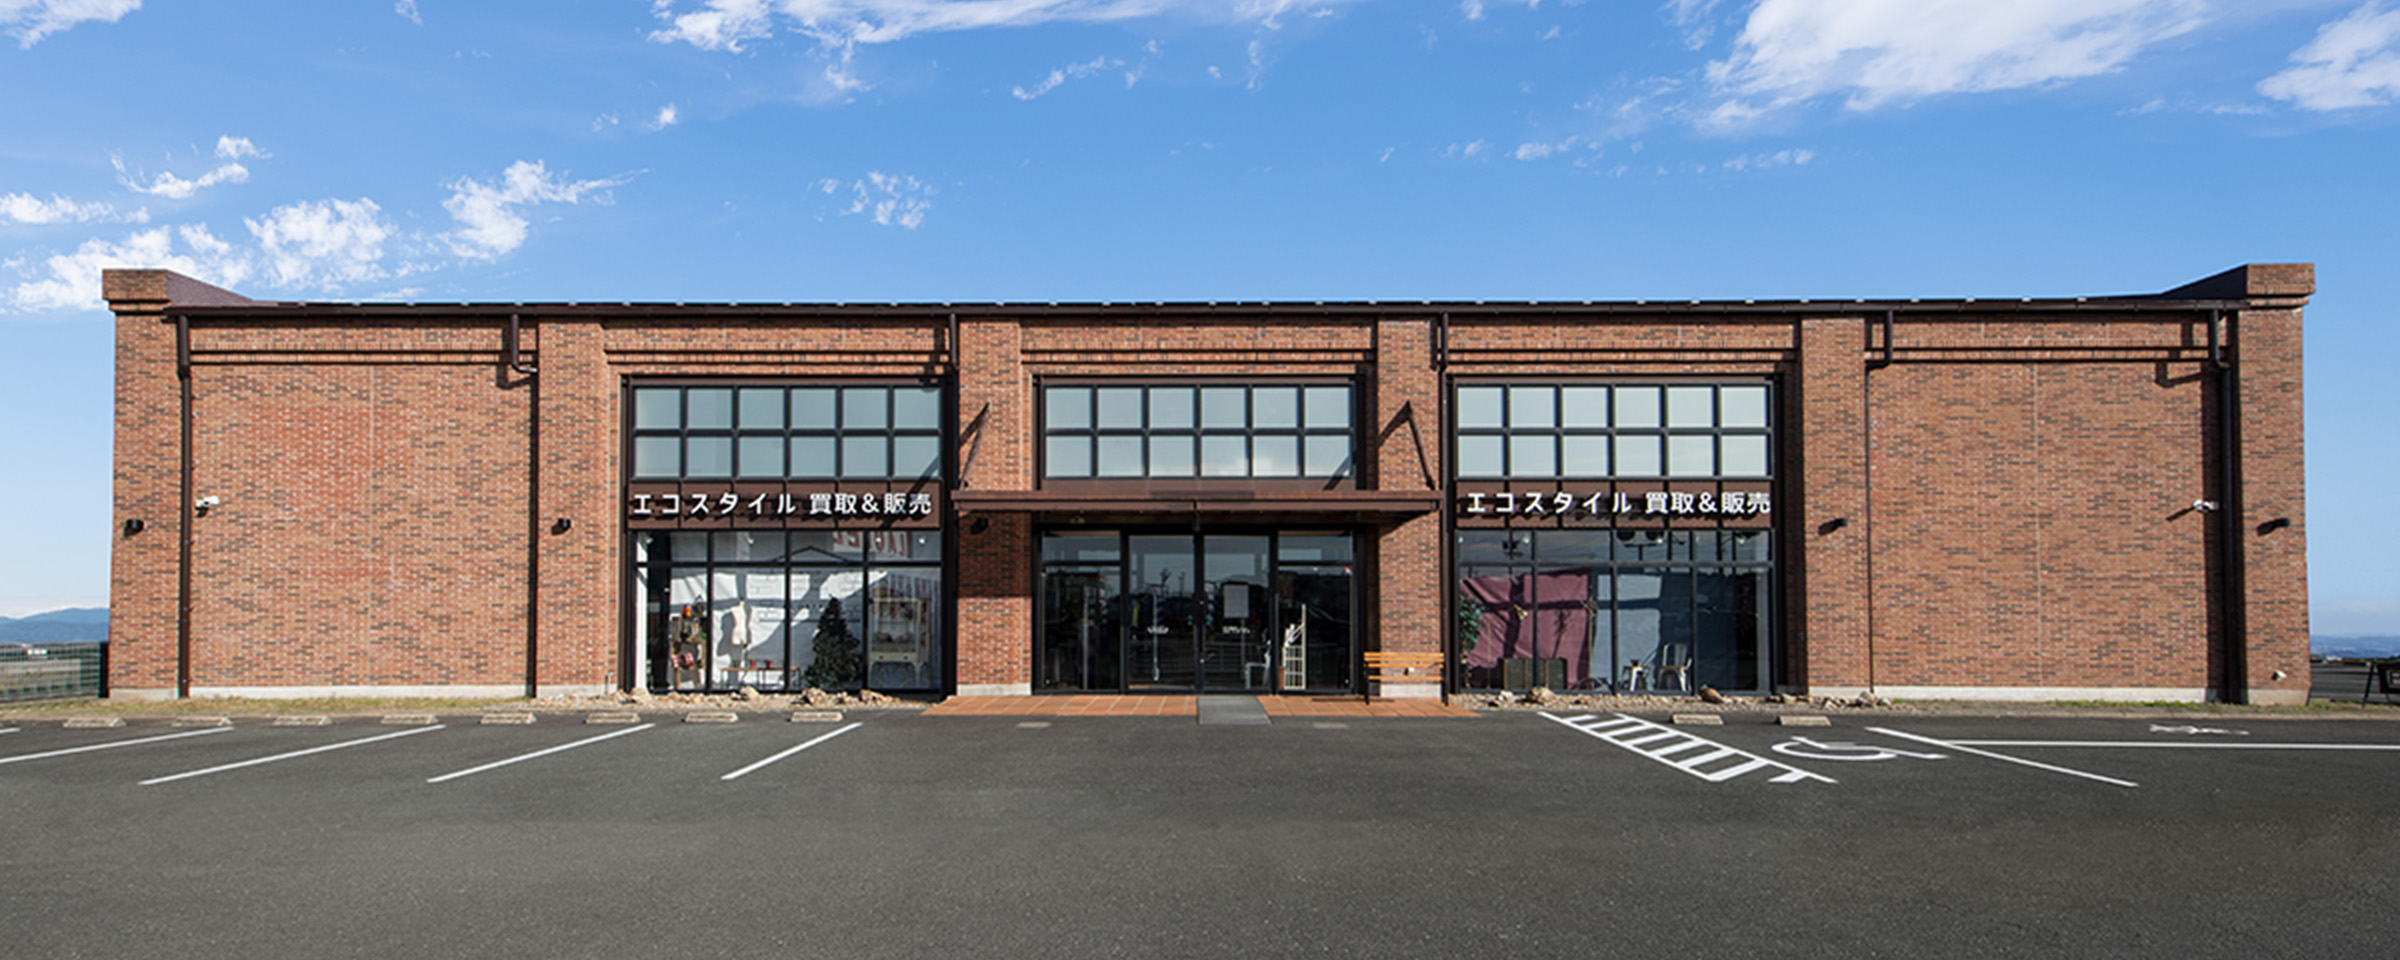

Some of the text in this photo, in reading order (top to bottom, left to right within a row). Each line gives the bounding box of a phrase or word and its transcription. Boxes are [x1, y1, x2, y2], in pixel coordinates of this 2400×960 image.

[633, 492, 932, 514] エコスタイル 買取&販売
[1467, 491, 1771, 514] エコスタイル 買取&販売
